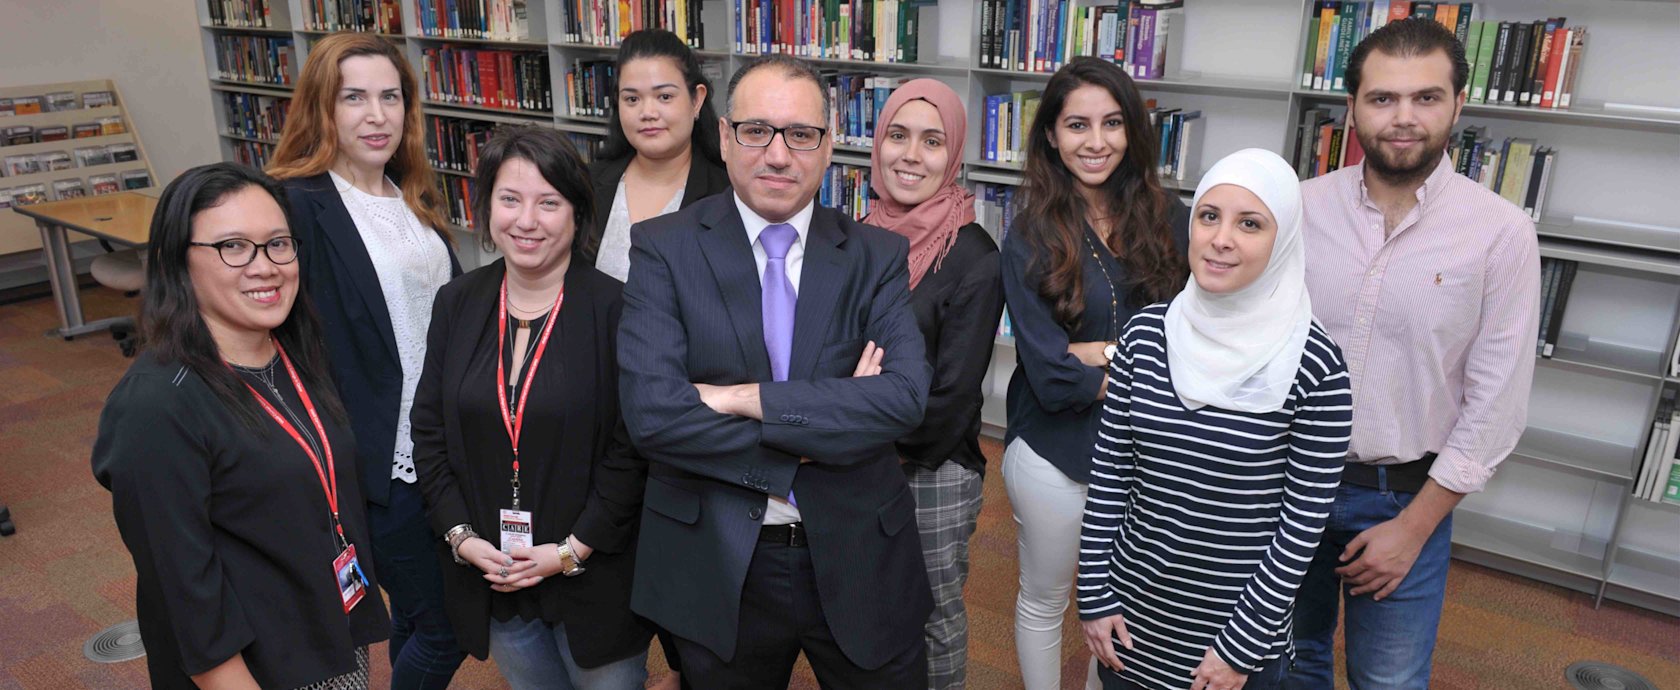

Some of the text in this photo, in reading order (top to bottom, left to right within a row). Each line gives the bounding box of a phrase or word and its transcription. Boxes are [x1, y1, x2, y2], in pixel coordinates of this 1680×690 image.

[1338, 18, 1347, 52] GUIDELINES
[1540, 33, 1553, 64] Medicine
[1341, 40, 1350, 69] PRACTICE
[502, 524, 529, 533] CARE
